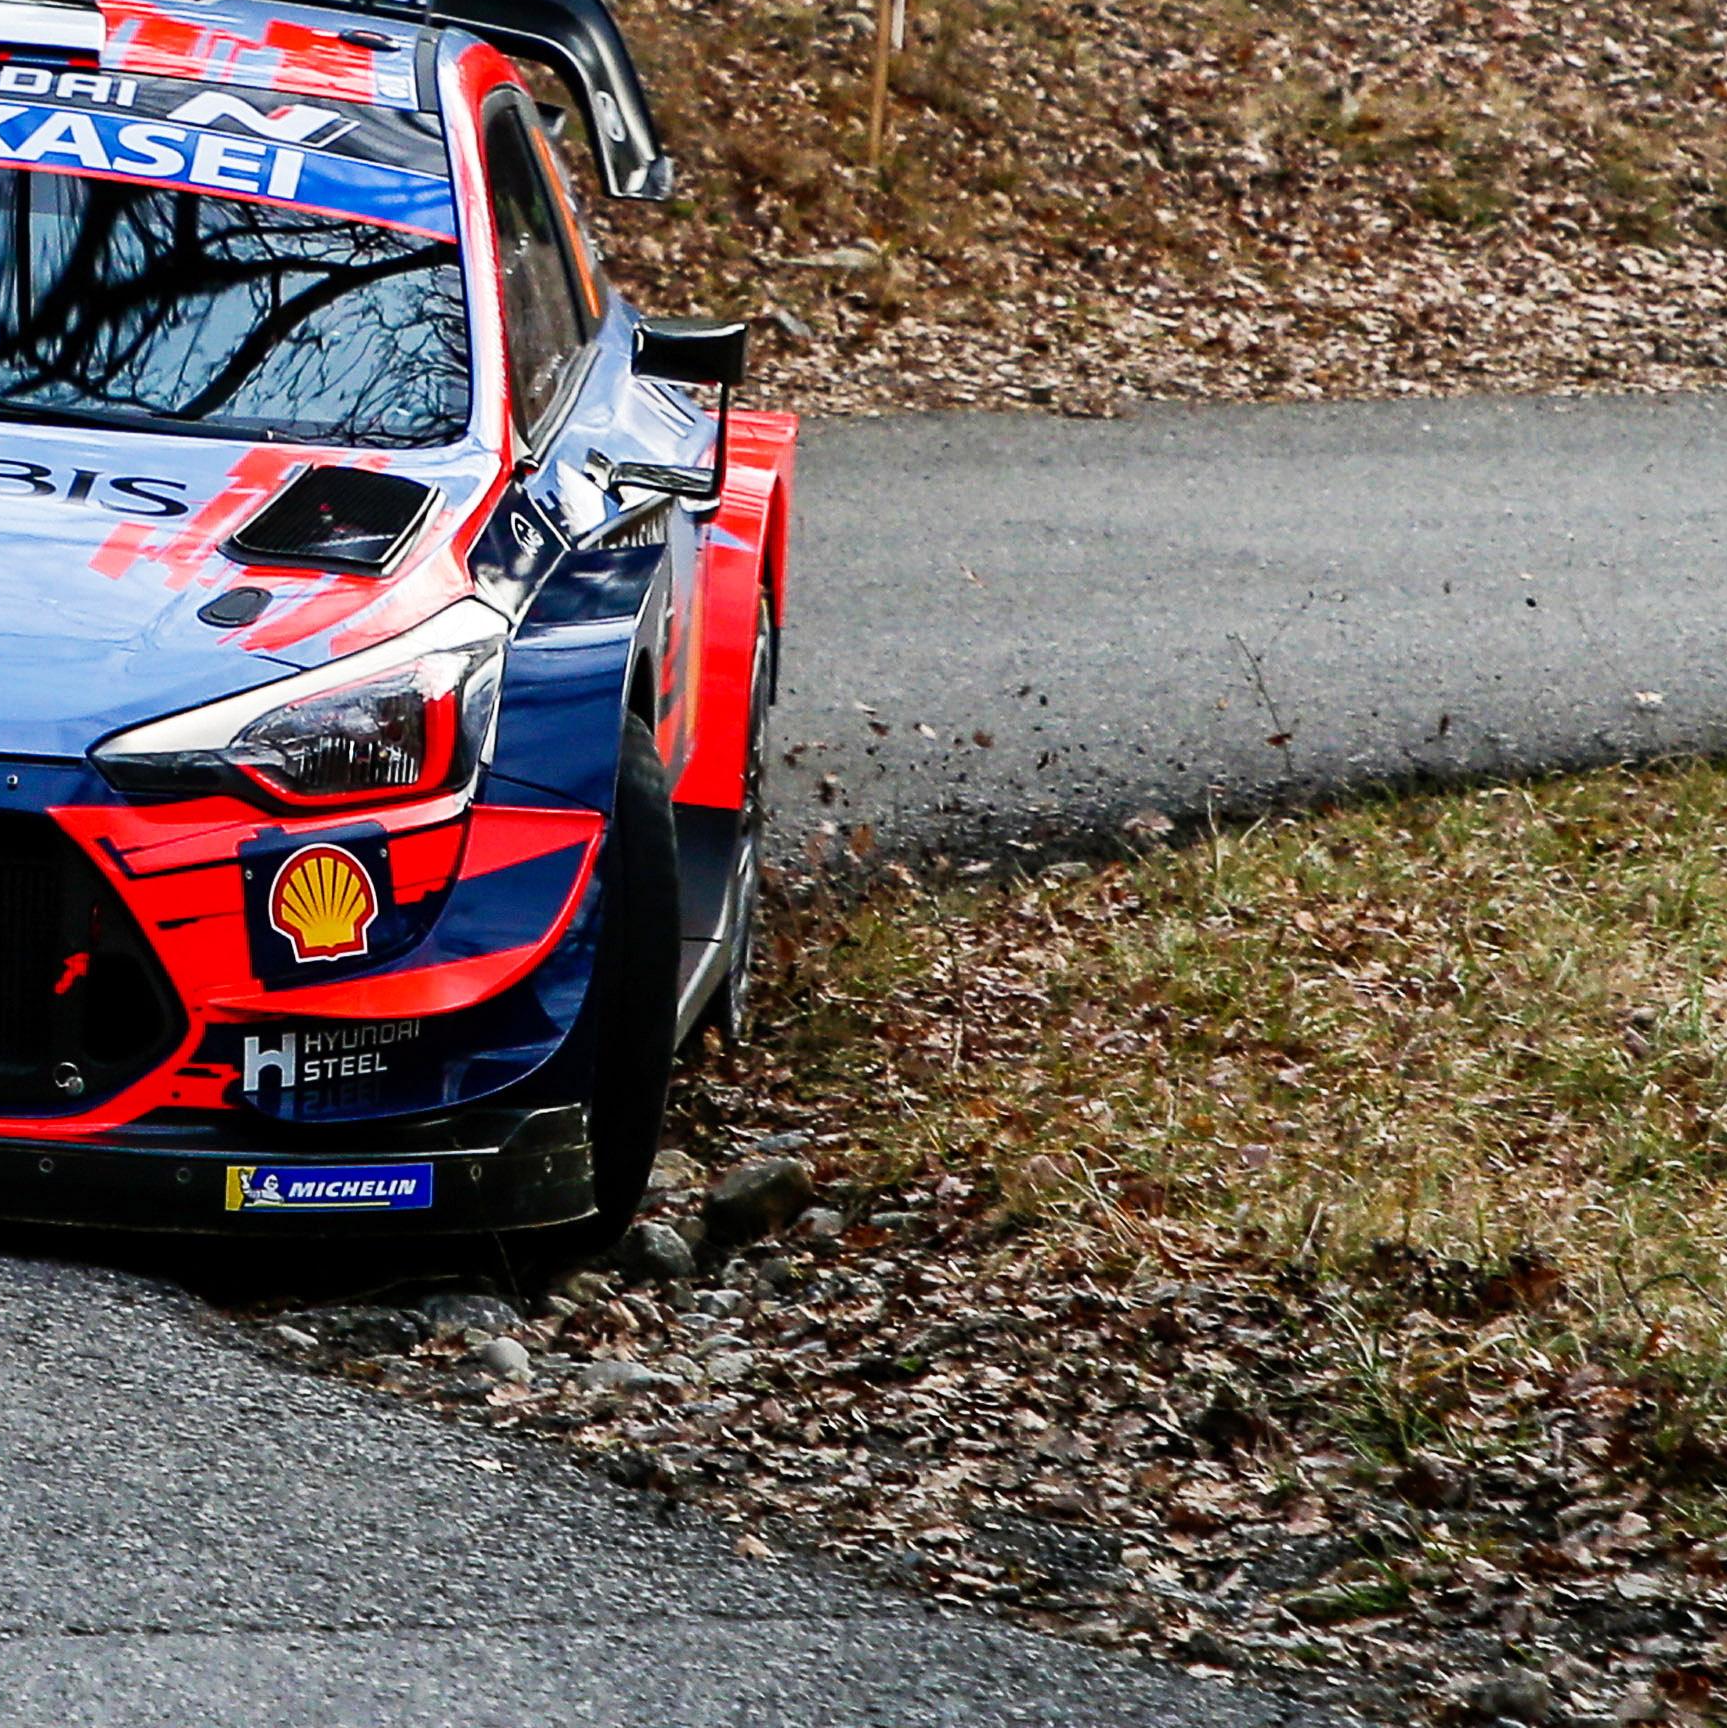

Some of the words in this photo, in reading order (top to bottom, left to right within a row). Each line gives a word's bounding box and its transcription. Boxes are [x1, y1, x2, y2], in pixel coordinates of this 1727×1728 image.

[304, 1019, 421, 1054] HYUNDAI
[303, 1052, 388, 1082] STEEL
[288, 1178, 417, 1198] MICHELIN
